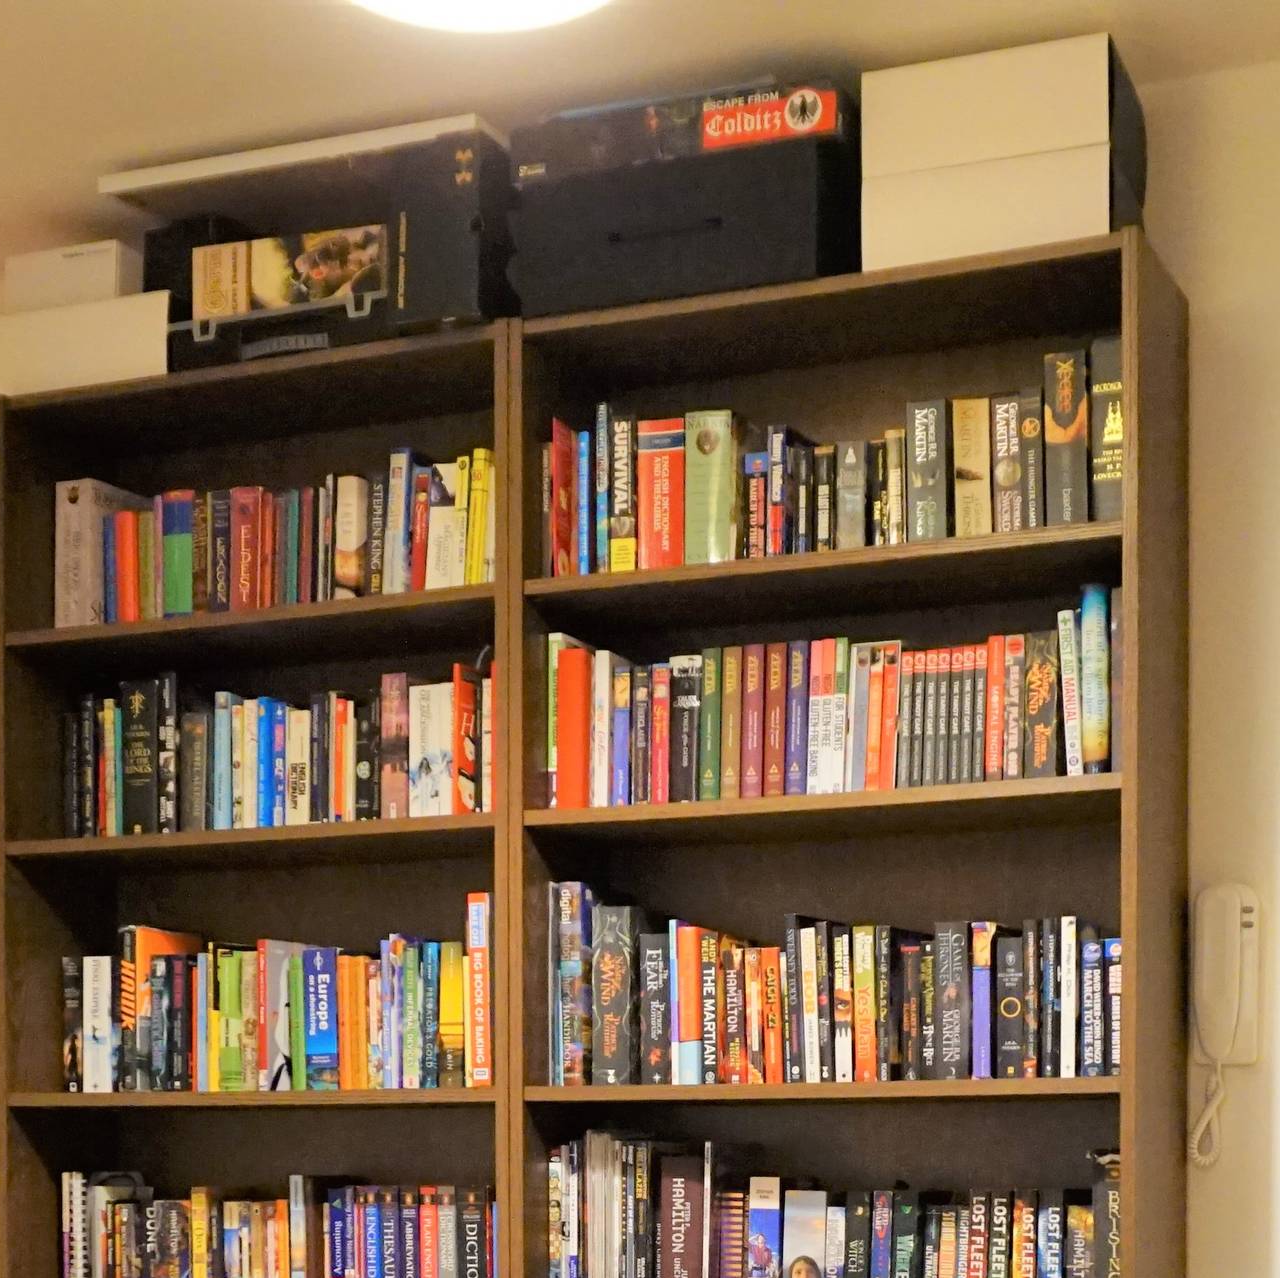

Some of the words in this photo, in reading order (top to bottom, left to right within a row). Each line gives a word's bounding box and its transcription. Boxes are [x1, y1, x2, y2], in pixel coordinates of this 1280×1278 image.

[748, 91, 779, 104] FROM
[705, 108, 782, 137] Colditz
[915, 409, 927, 463] MARTIN
[996, 403, 1009, 457] MARTIN
[614, 421, 628, 515] SURVIVAL
[372, 483, 383, 536] STEPHEN
[749, 478, 758, 512] MARCH
[1028, 500, 1036, 527] GAMES
[1063, 488, 1072, 521] baxter
[661, 497, 669, 551] DICTIONARY
[749, 514, 757, 526] TO
[240, 525, 252, 602] ELDEST
[370, 540, 382, 570] KING
[1061, 628, 1071, 655] FIRST
[1063, 659, 1073, 676] AID
[835, 697, 844, 712] FOR
[939, 696, 947, 717] TAROT
[991, 685, 999, 726] MORTAL
[1029, 676, 1041, 715] WIND
[1064, 677, 1076, 723] MANUAL
[833, 714, 843, 752] STUDENTS
[990, 730, 998, 772] ENGINES
[809, 750, 818, 777] BAKING
[560, 889, 575, 924] digital
[474, 952, 483, 970] BIG
[787, 928, 796, 973] SWEENEY
[938, 931, 951, 986] THRONES
[952, 933, 965, 972] GAME
[599, 965, 614, 1005] WIND
[645, 948, 663, 991] FEAR
[702, 967, 715, 996] THE
[317, 973, 330, 1031] Europe
[474, 974, 484, 1005] BOOK
[726, 969, 738, 1033] HAMILTON
[1084, 969, 1093, 1012] MARCH
[475, 1007, 484, 1023] OF
[703, 999, 716, 1065] MARTIAN
[1084, 1013, 1093, 1027] TO
[475, 1026, 485, 1064] BAKING
[942, 1009, 953, 1062] MARTIN
[1084, 1028, 1093, 1046] THE
[426, 1043, 434, 1068] GOLD
[1084, 1047, 1094, 1065] SEA
[146, 1207, 157, 1253] DUNE
[424, 1218, 432, 1247] PLAIN
[671, 1178, 685, 1253] HAMILTON
[971, 1196, 986, 1232] LOST
[992, 1198, 1007, 1234] LOST
[1022, 1207, 1034, 1239] LOST
[1047, 1207, 1061, 1239] LOST
[367, 1217, 376, 1264] ENGLISH
[439, 1216, 447, 1270] DICTIONARY
[848, 1239, 858, 1272] WITCH
[958, 1210, 970, 1278] NIGHTBRINGER
